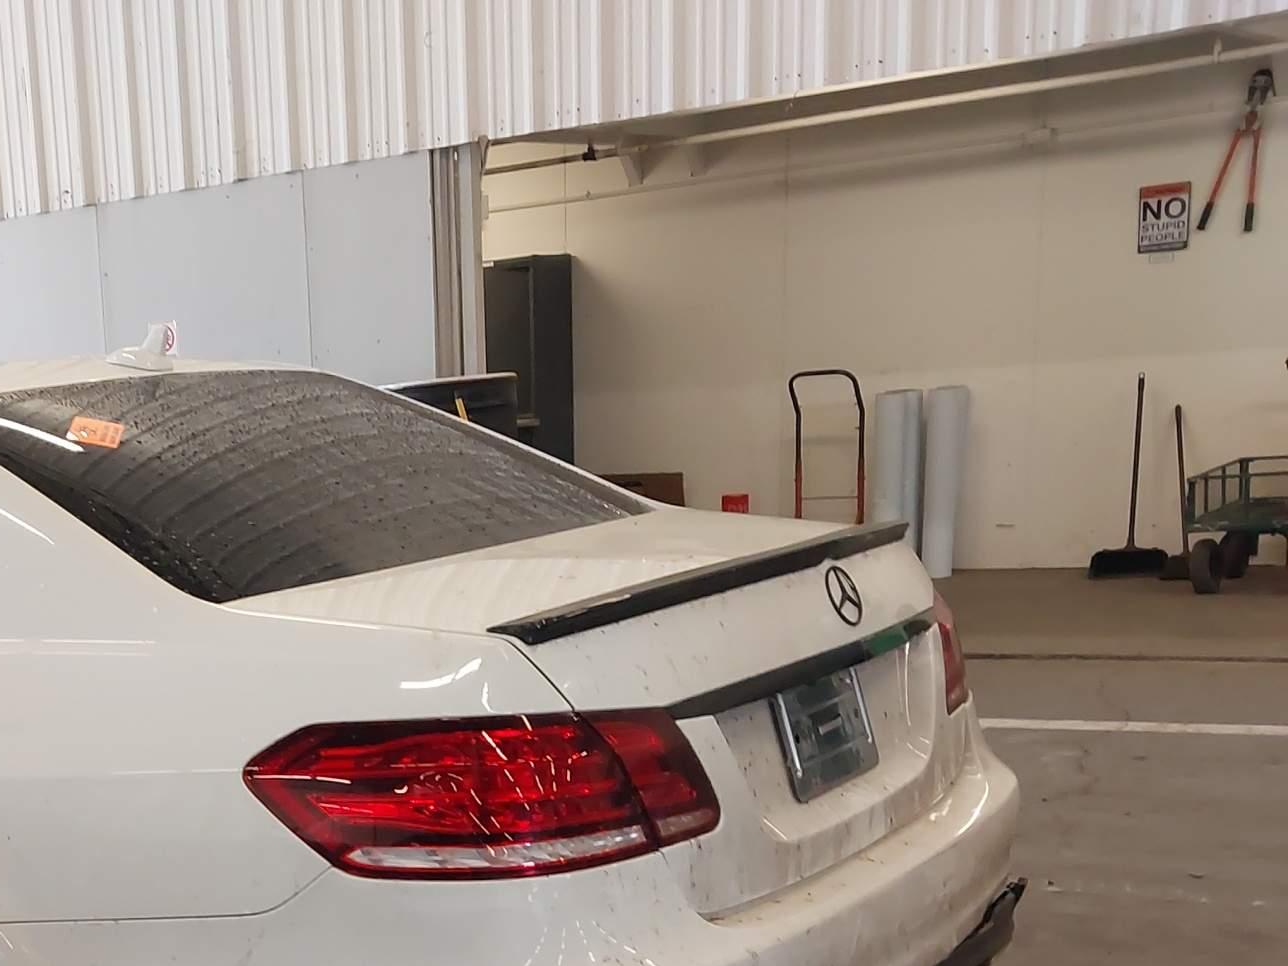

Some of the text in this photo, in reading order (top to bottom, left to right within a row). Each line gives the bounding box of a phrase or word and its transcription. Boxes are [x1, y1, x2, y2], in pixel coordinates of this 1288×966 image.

[1143, 197, 1186, 221] NO
[1142, 220, 1185, 232] STUPID
[1141, 231, 1185, 242] PEOPLE
